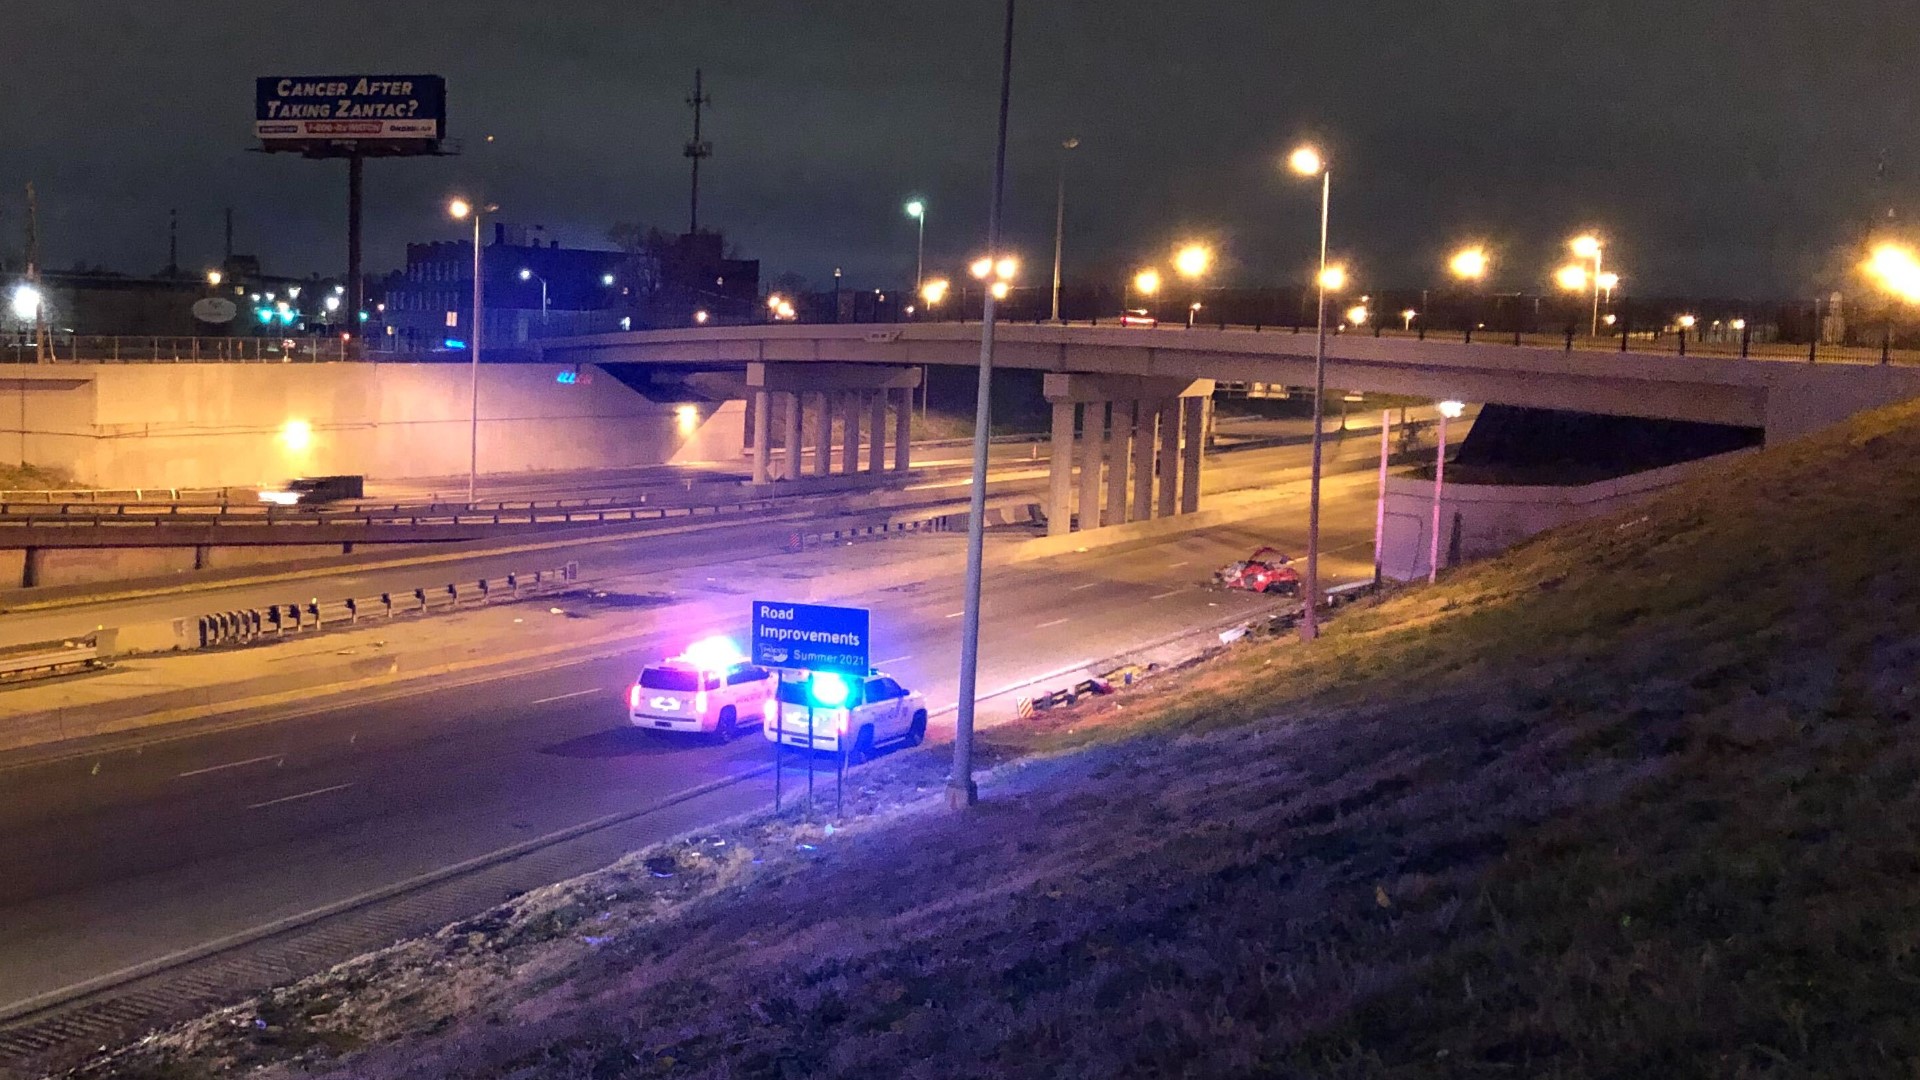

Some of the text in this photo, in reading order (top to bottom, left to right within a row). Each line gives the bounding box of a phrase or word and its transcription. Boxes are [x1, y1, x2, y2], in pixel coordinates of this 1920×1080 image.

[276, 77, 414, 97] CANCER AFTER
[267, 99, 419, 118] TAKING ZANTAC?
[760, 605, 794, 620] Road
[760, 623, 860, 647] Improvements
[793, 649, 838, 663] Summer
[839, 654, 864, 666] 2021
